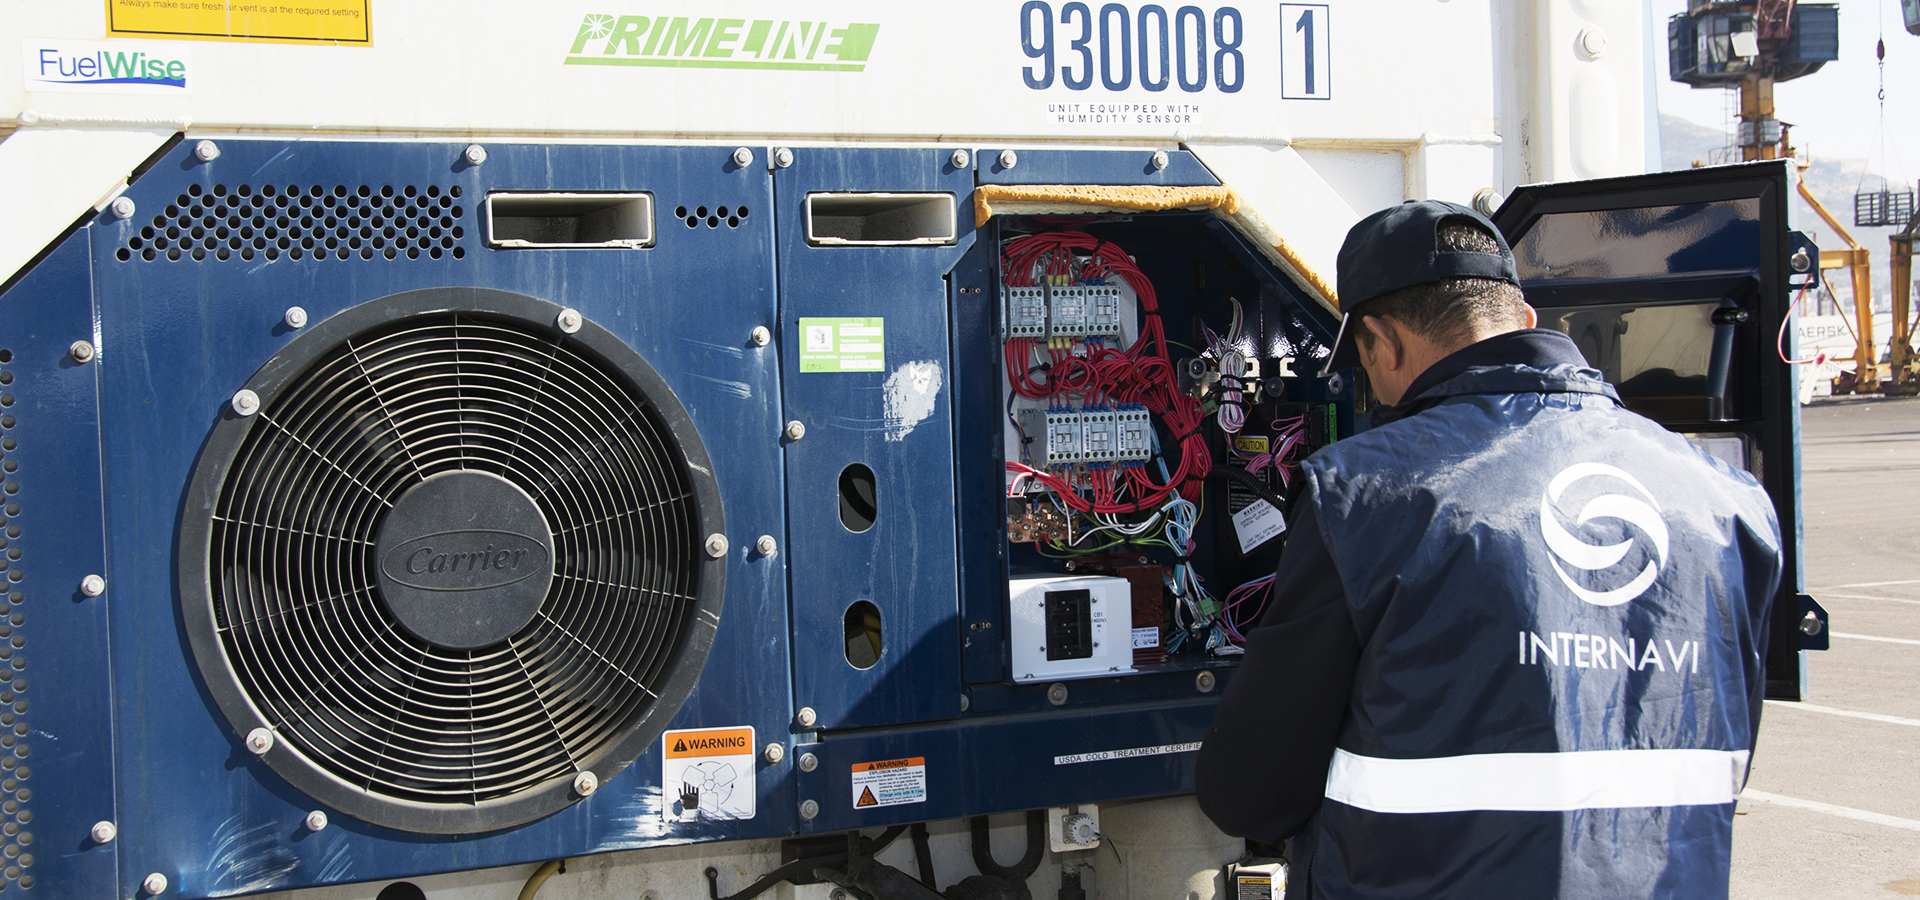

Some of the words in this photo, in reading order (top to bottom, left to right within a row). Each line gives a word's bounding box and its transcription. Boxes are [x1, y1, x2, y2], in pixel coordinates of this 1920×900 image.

[120, 0, 151, 9] Always
[202, 2, 223, 10] fresh
[296, 8, 329, 16] required
[332, 9, 361, 18] setting.
[569, 13, 880, 61] PRIMELINE
[1020, 0, 1244, 93] 930008
[1296, 10, 1314, 94] 1
[40, 49, 186, 80] FuelWise
[1049, 104, 1080, 112] UNIT
[1090, 105, 1157, 113] EQUIPPED
[1240, 440, 1264, 450] CAUTION
[1243, 501, 1264, 516] WARNING
[406, 544, 528, 574] Carrier
[1519, 631, 1698, 674] INTERNAVI
[689, 737, 745, 749] WARNING
[876, 759, 908, 768] WARNING
[1059, 755, 1082, 763] USDA
[1086, 753, 1108, 761] COLD
[1113, 747, 1160, 758] TREATMENT
